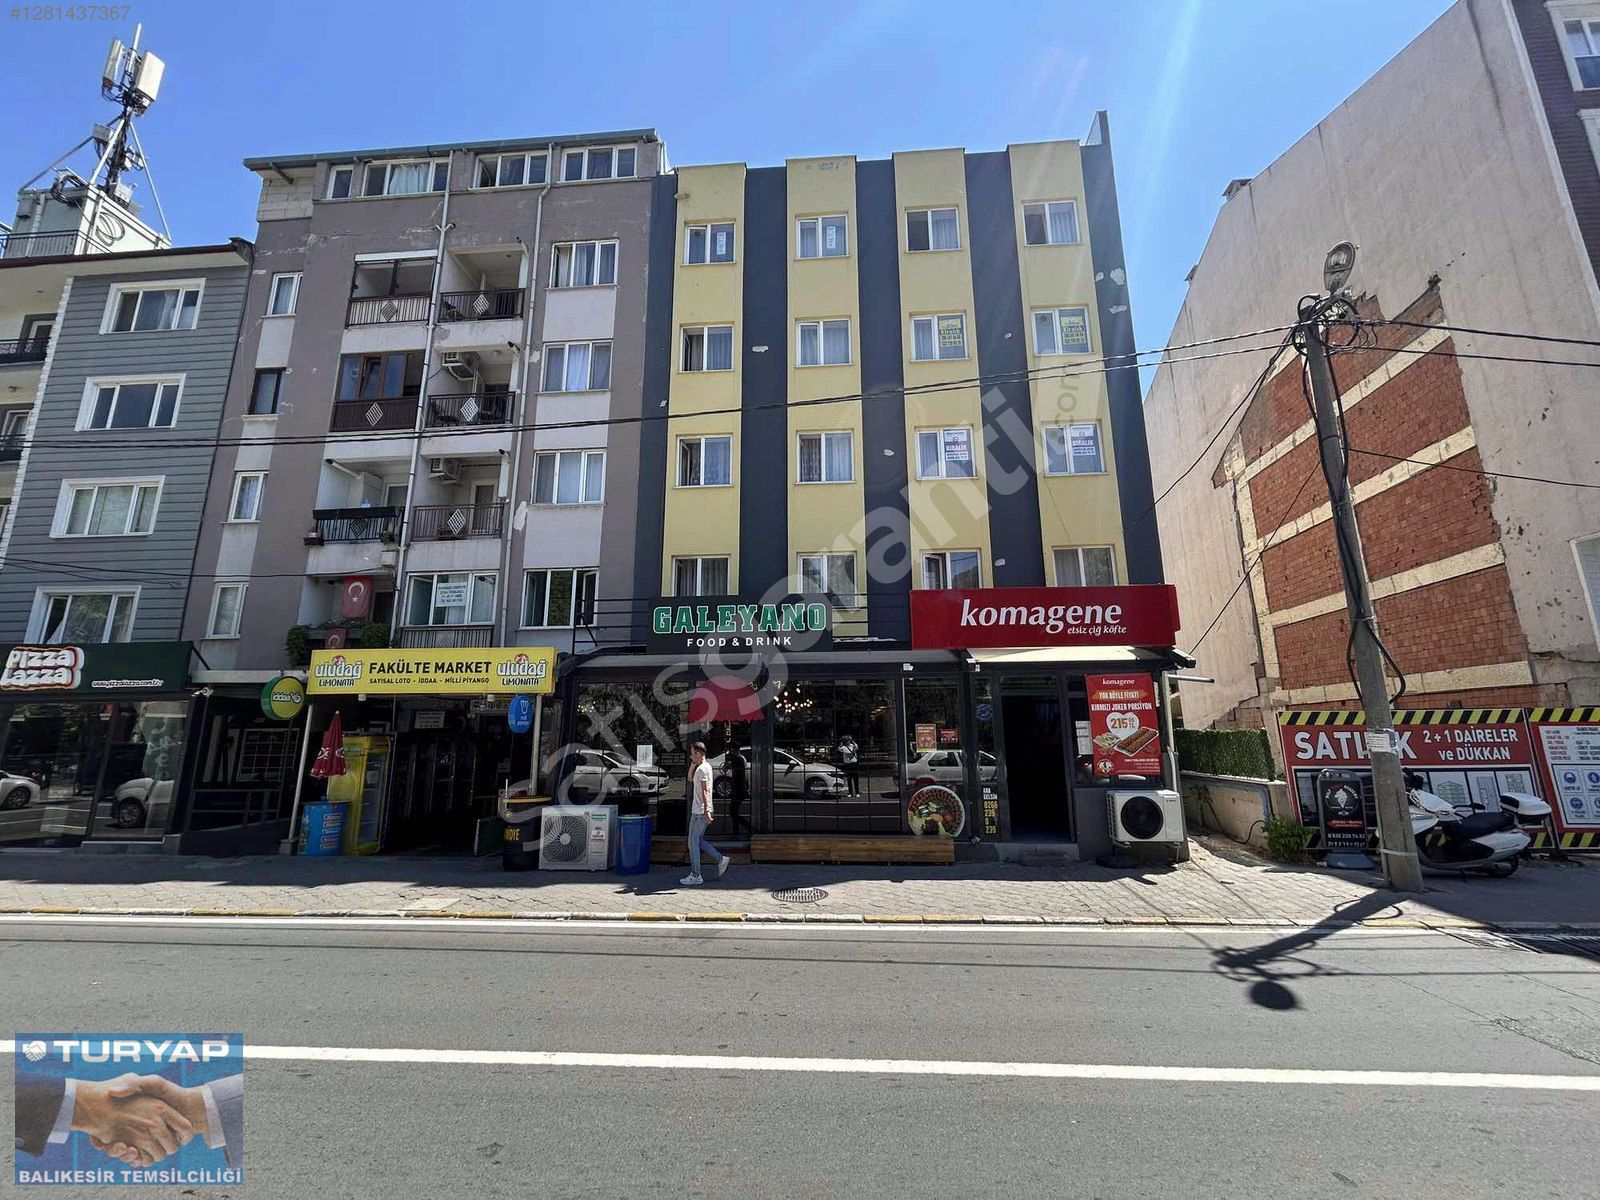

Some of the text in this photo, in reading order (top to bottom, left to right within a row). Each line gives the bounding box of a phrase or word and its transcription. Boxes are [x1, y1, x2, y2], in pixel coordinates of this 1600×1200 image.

[652, 602, 827, 634] GALEYANO
[960, 599, 1122, 634] komagene
[1067, 624, 1127, 637] etsiz çiğ köfte
[687, 636, 792, 647] FOOD & DRINK
[314, 659, 363, 678] uludağ
[369, 659, 492, 674] FAKÜLTE MARKET
[496, 659, 547, 678] uludağ
[1102, 678, 1135, 687] komagene
[1110, 718, 1127, 729] 215
[1453, 725, 1519, 742] DAİRELER
[1294, 731, 1418, 760] SATIK
[1438, 743, 1511, 760] ve DÜKKAN
